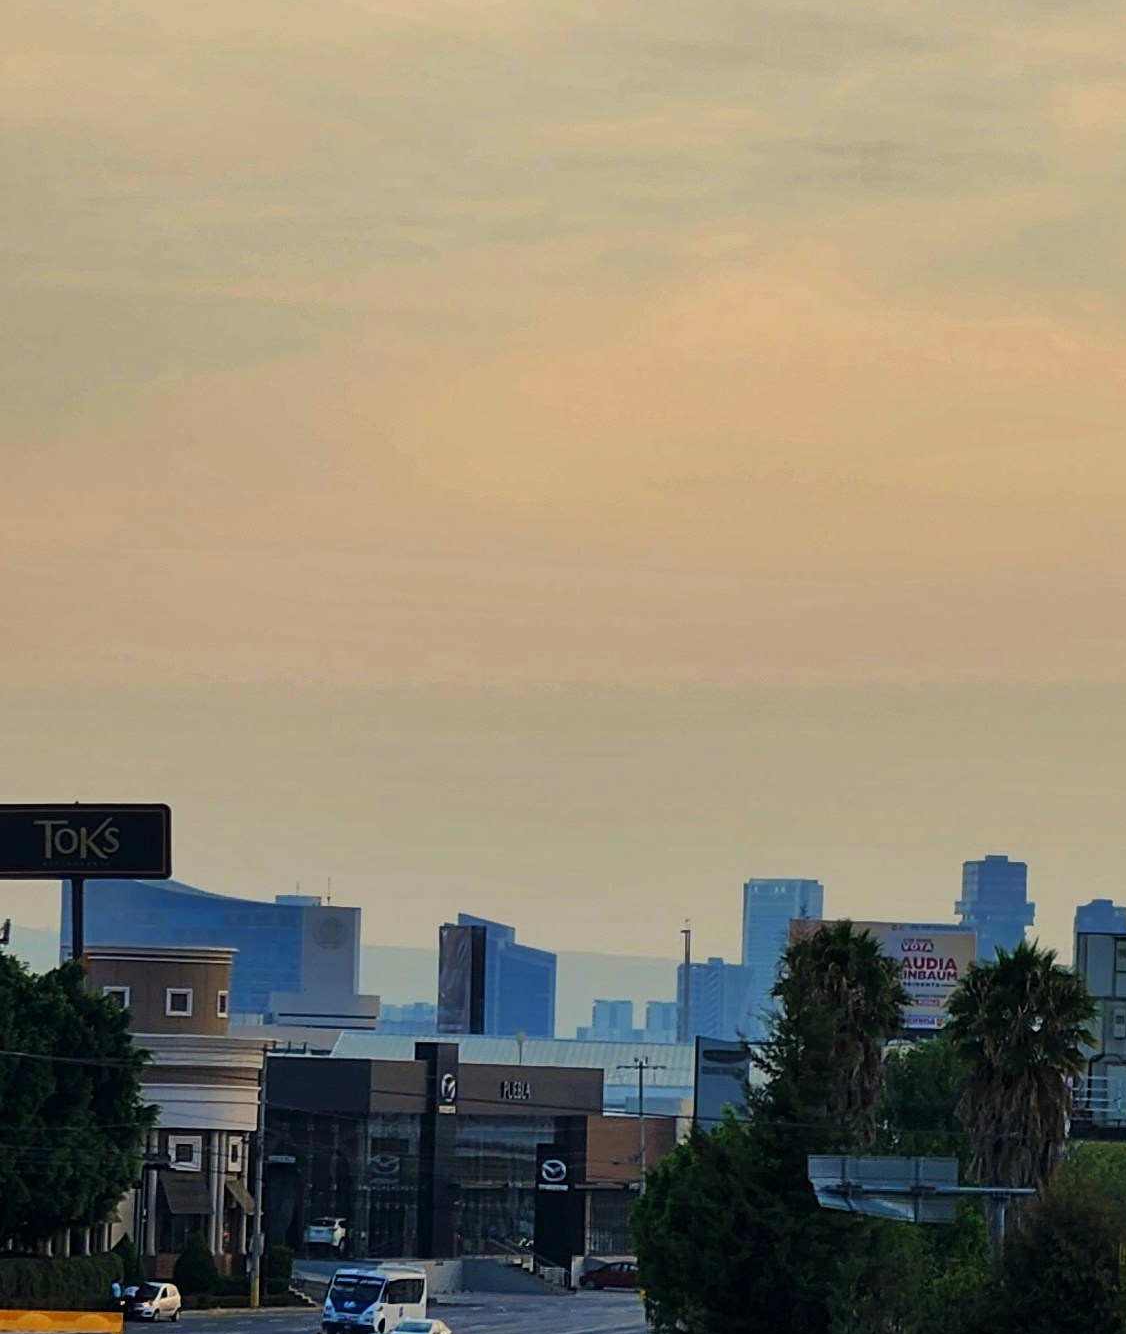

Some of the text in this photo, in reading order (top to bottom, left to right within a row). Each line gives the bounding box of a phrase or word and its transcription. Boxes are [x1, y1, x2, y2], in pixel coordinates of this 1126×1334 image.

[902, 957, 957, 970] AUDIA
[903, 970, 957, 981] INBAUM
[502, 1081, 531, 1099] PUEBLA
